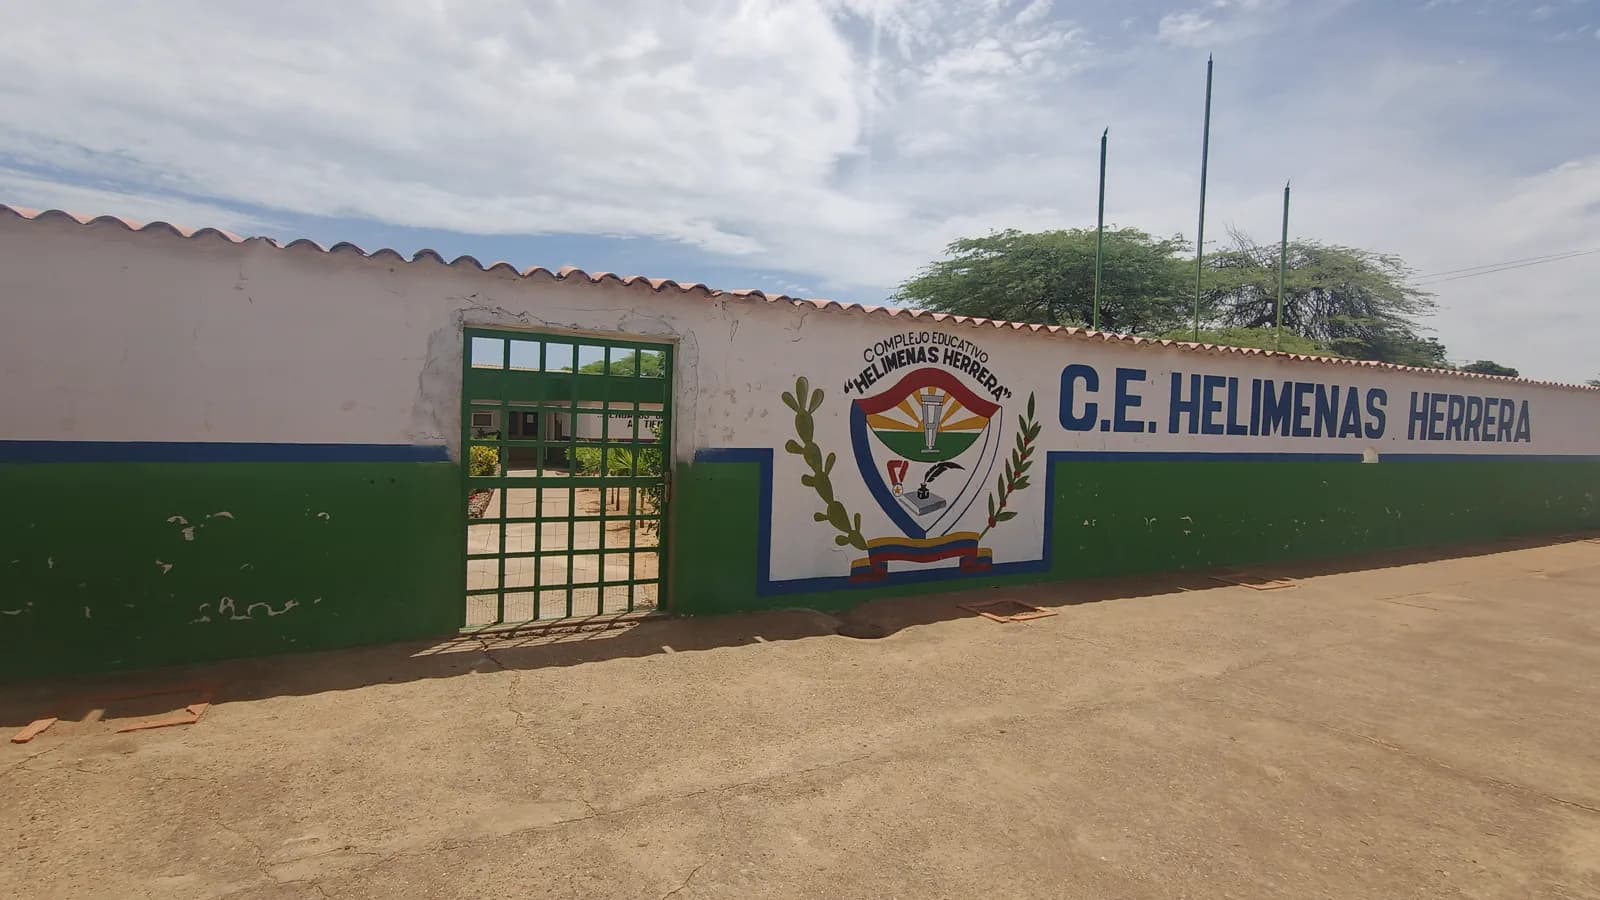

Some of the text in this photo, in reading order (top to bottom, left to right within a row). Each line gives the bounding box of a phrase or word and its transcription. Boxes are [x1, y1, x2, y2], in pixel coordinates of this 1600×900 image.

[863, 331, 989, 363] COMPLEJO EDUCATIVO
[1059, 364, 1531, 442] C.E. HELIMENAS HERRERA
